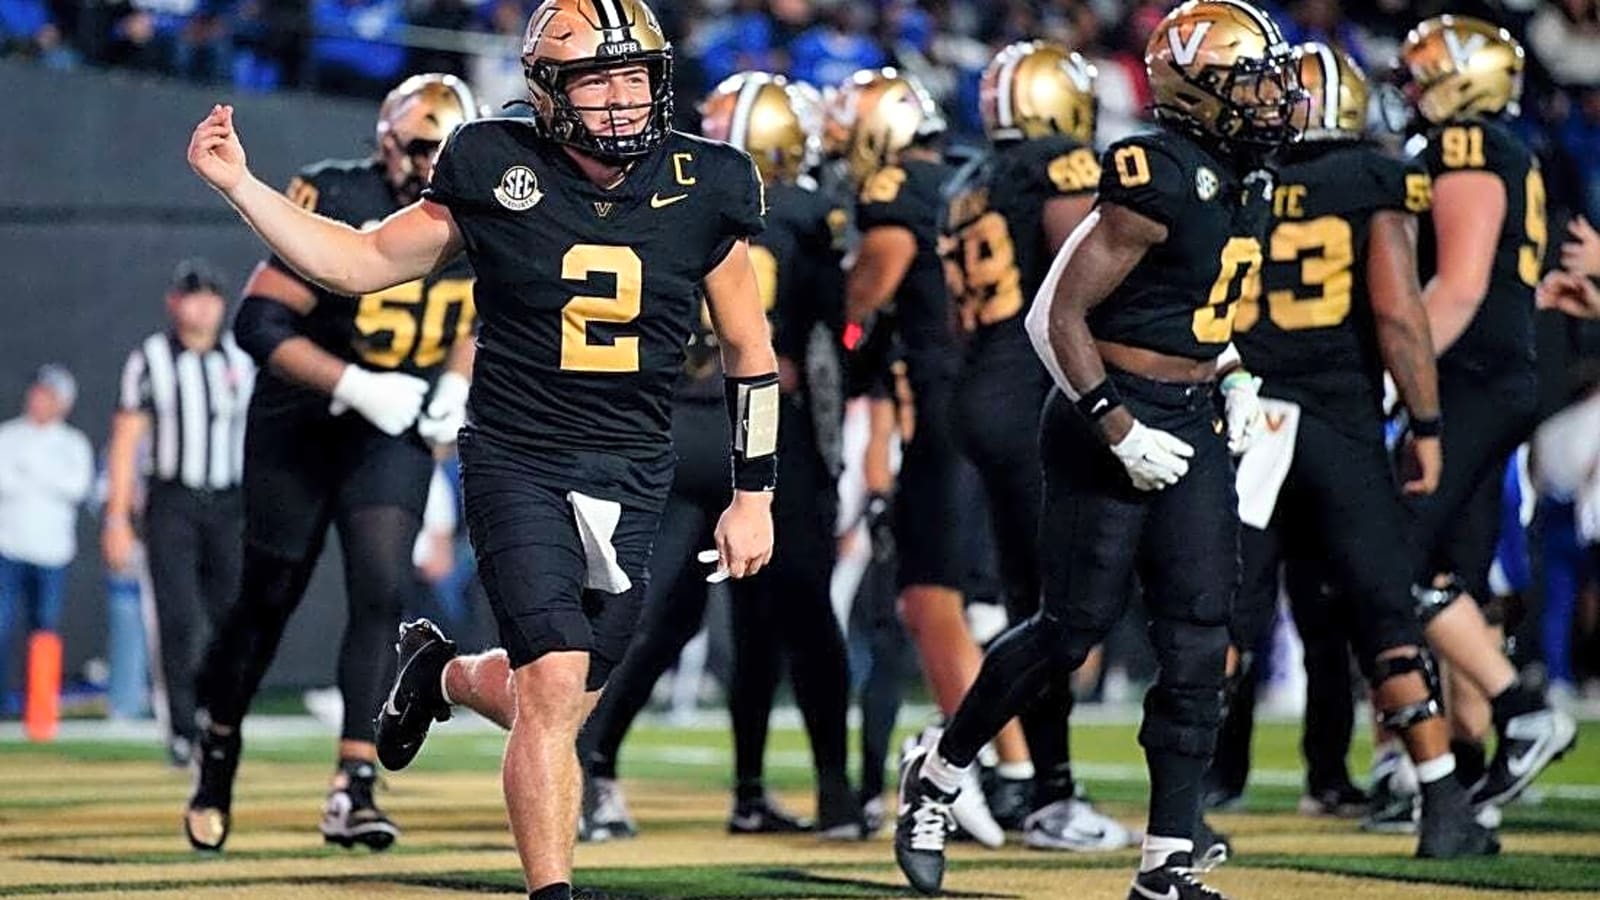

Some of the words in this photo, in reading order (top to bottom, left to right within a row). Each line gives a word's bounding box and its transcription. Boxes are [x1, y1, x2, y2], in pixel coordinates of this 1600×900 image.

[605, 43, 638, 54] VUFB
[1114, 145, 1150, 187] 0
[1441, 126, 1486, 168] 91
[504, 168, 535, 199] SEC
[673, 153, 696, 185] C
[354, 277, 476, 368] 50
[561, 244, 642, 371] 2
